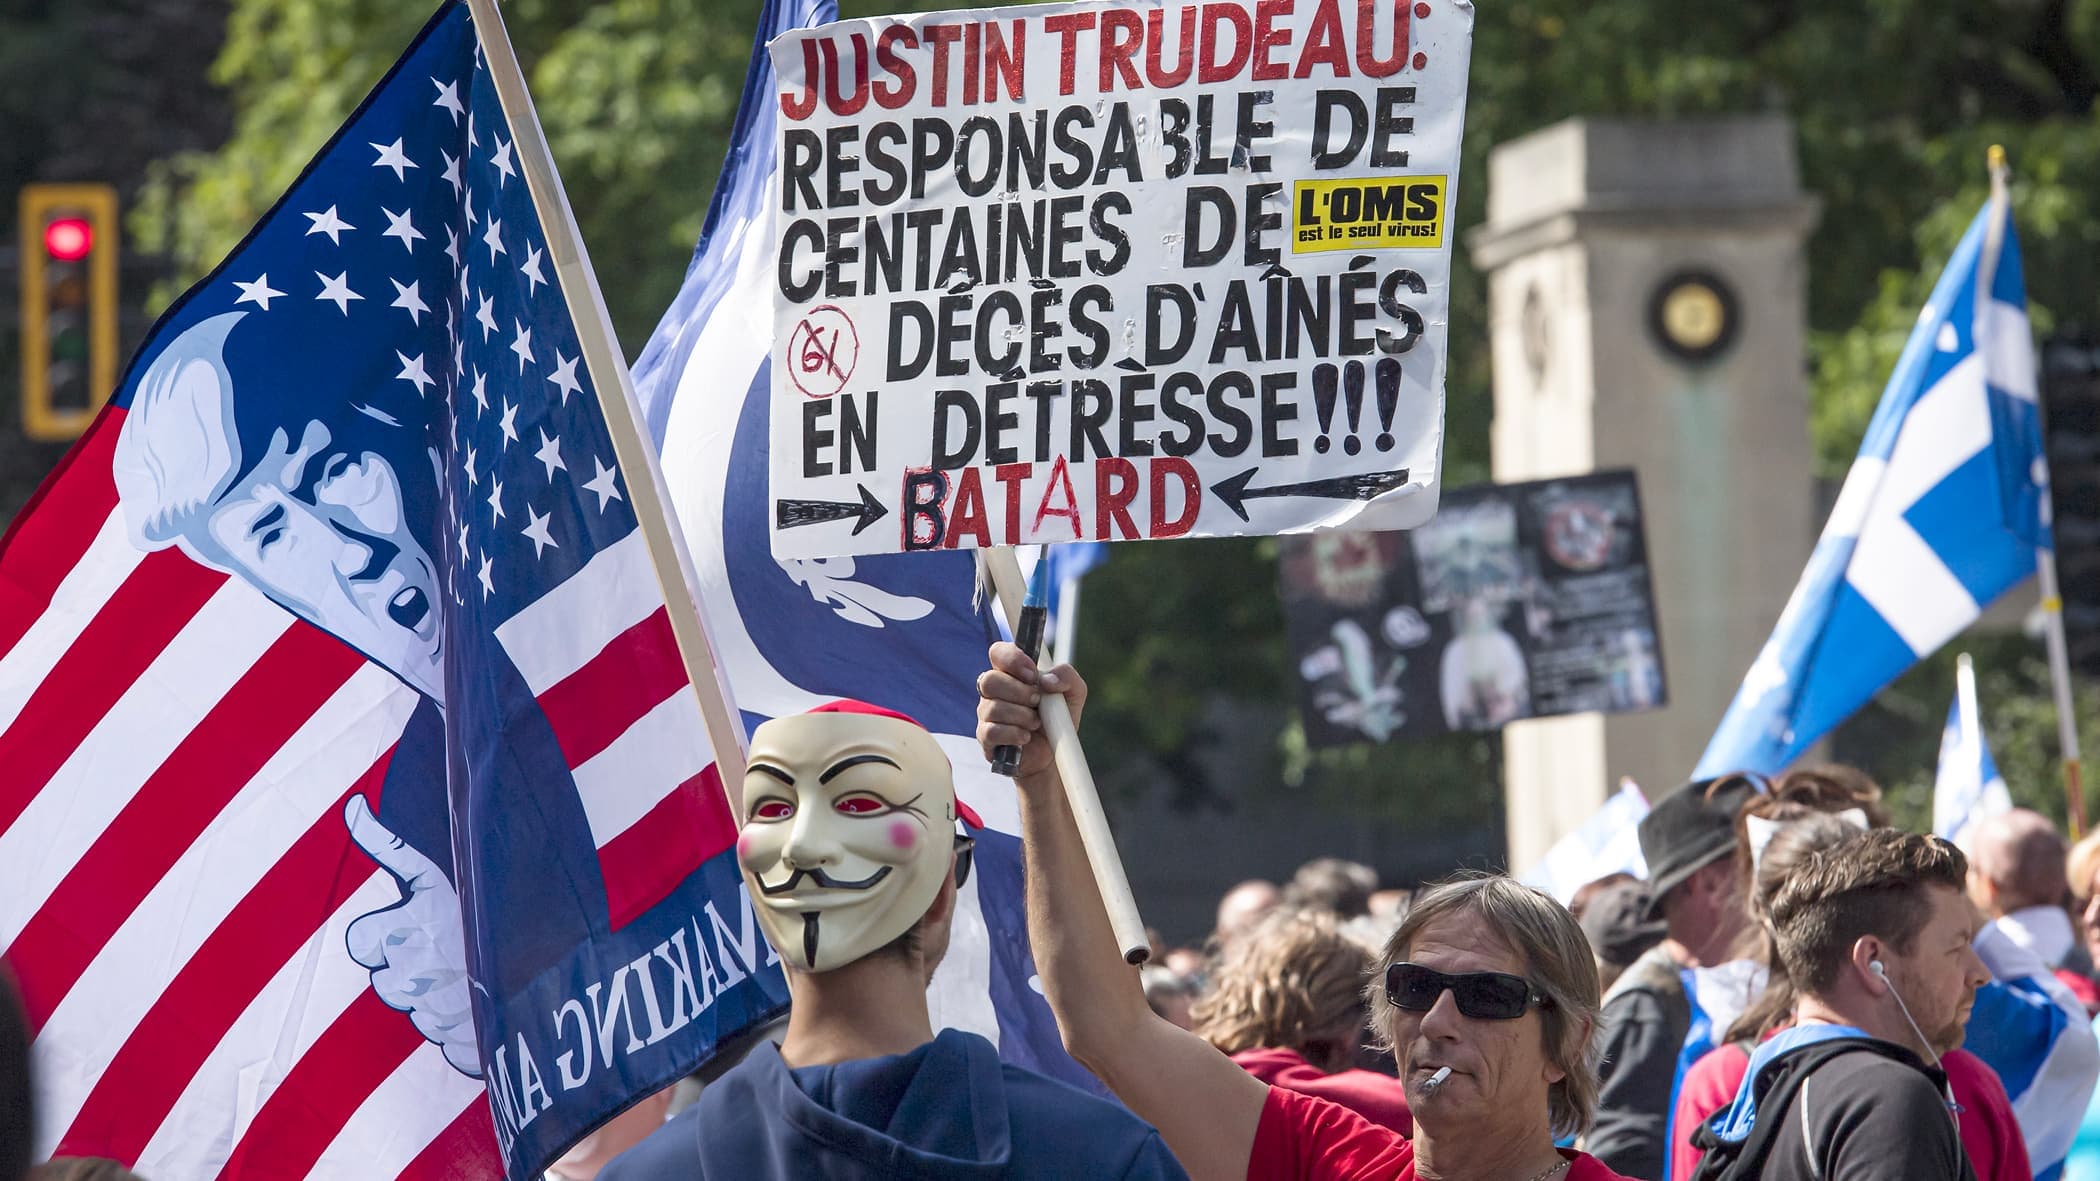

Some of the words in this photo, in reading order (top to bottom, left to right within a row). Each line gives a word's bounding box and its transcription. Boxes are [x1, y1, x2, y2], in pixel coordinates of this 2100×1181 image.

[780, 19, 1026, 121] JUSTIN
[1045, 0, 1431, 96] TRUDEAU:
[783, 90, 1274, 211] RESPONSABLE
[1312, 87, 1417, 171] DE
[778, 191, 1132, 303] CENTAINES
[1183, 181, 1285, 268] DE
[1298, 226, 1323, 242] est
[1329, 225, 1343, 239] le
[1348, 223, 1382, 238] seul
[1388, 222, 1437, 237] virus!
[1300, 184, 1439, 226] L'OMS
[886, 279, 1114, 382] DÉCÈS
[1145, 255, 1428, 366] D'AÎNÉS
[802, 391, 878, 479] EN
[901, 453, 1202, 550] BATARD
